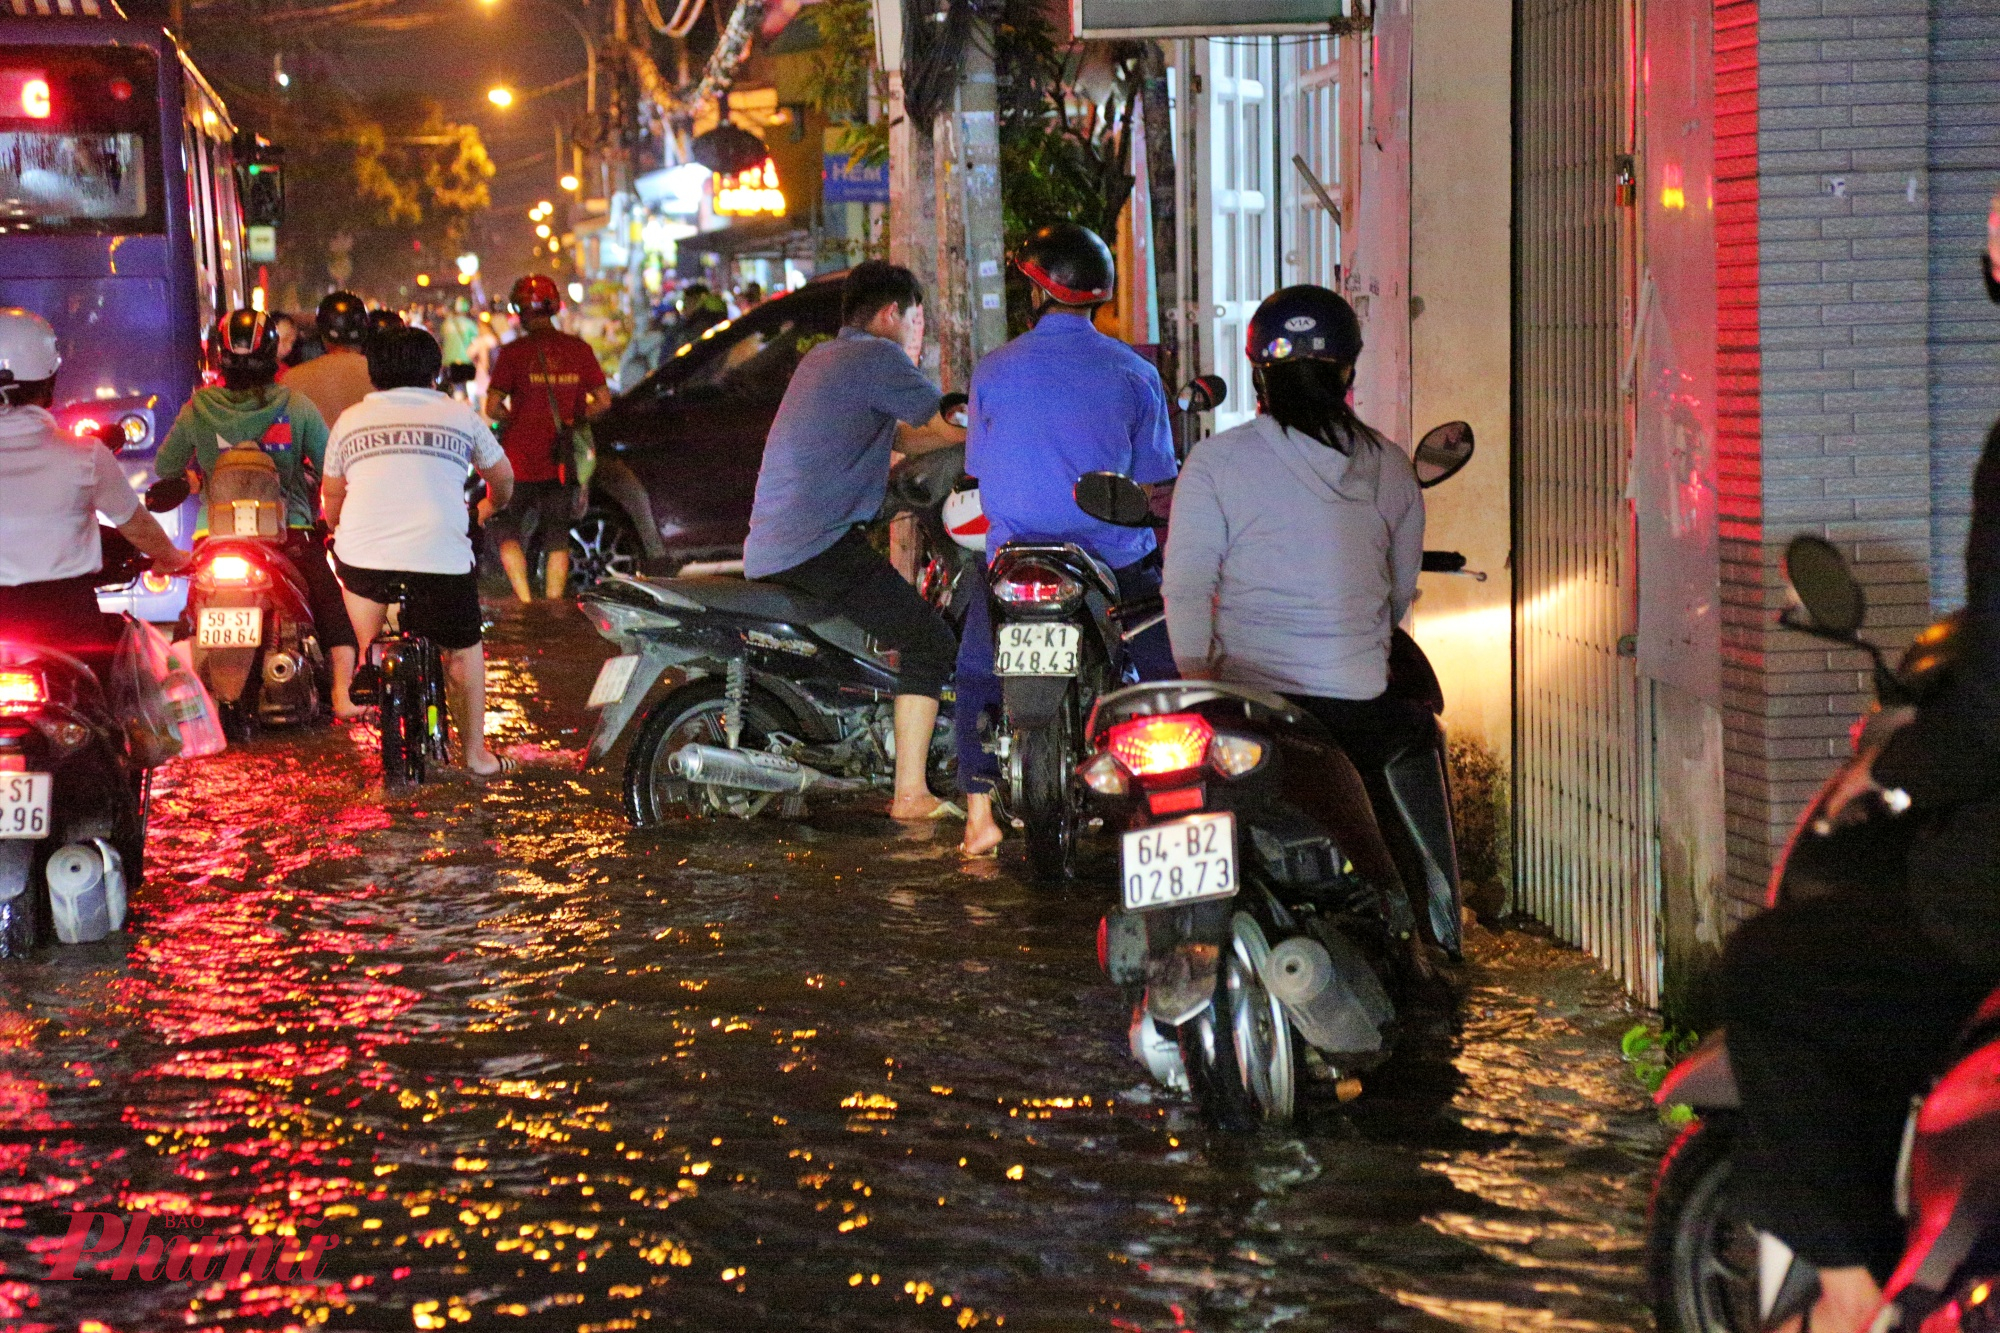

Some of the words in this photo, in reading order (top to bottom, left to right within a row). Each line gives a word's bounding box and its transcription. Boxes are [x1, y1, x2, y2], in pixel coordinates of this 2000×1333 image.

[432, 432, 467, 458] DIOR
[201, 628, 256, 645] 308.64
[1010, 627, 1067, 647] 94-K1
[1000, 650, 1075, 673] 048.43
[1138, 823, 1217, 865] 64-B2
[1129, 857, 1229, 904] 028.73
